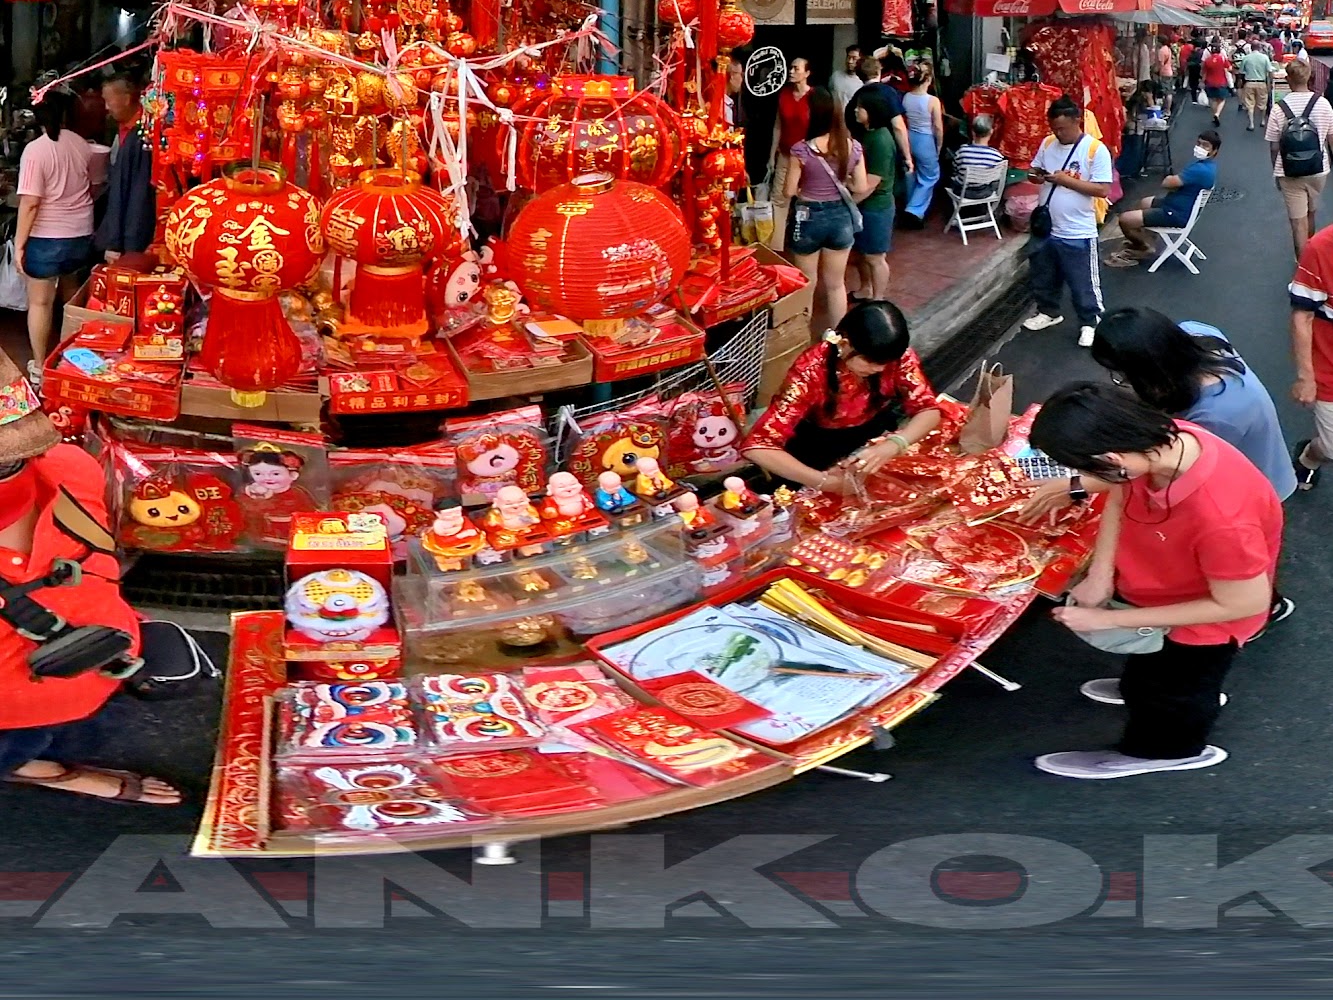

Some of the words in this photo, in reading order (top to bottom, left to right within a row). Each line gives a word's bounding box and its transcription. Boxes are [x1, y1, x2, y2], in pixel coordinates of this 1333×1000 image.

[807, 0, 851, 10] SELECTION
[993, 0, 1031, 14] Coca-Cola
[348, 393, 451, 408] 精品利是封
